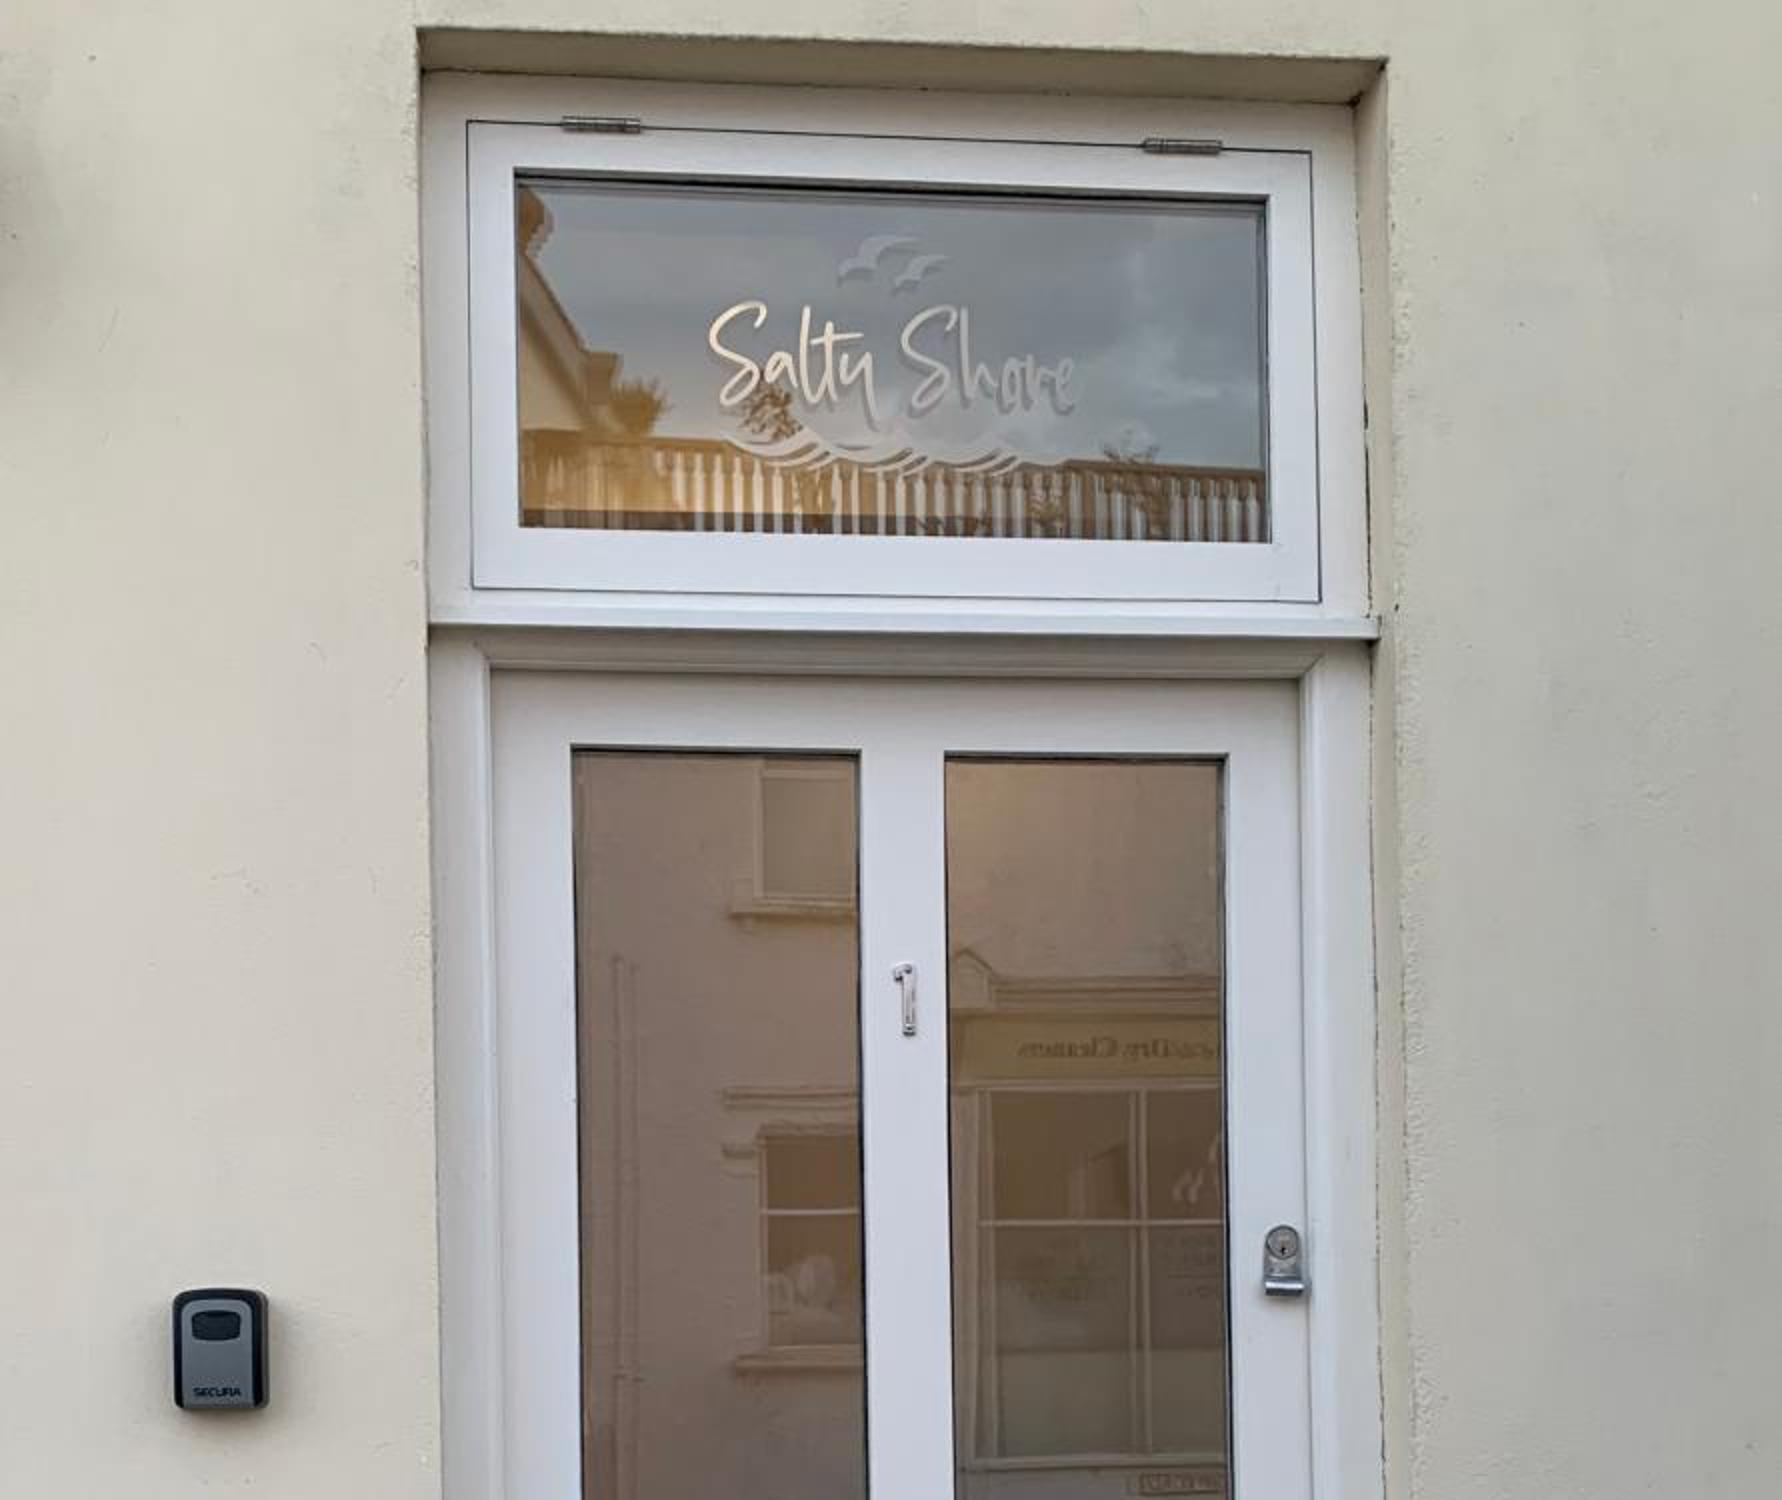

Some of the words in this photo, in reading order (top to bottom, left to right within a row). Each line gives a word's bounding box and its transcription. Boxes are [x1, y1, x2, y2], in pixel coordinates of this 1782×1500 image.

[708, 301, 881, 431] Salty
[901, 303, 1076, 415] Shore
[894, 962, 916, 1036] 1
[193, 1387, 241, 1398] SECURA
